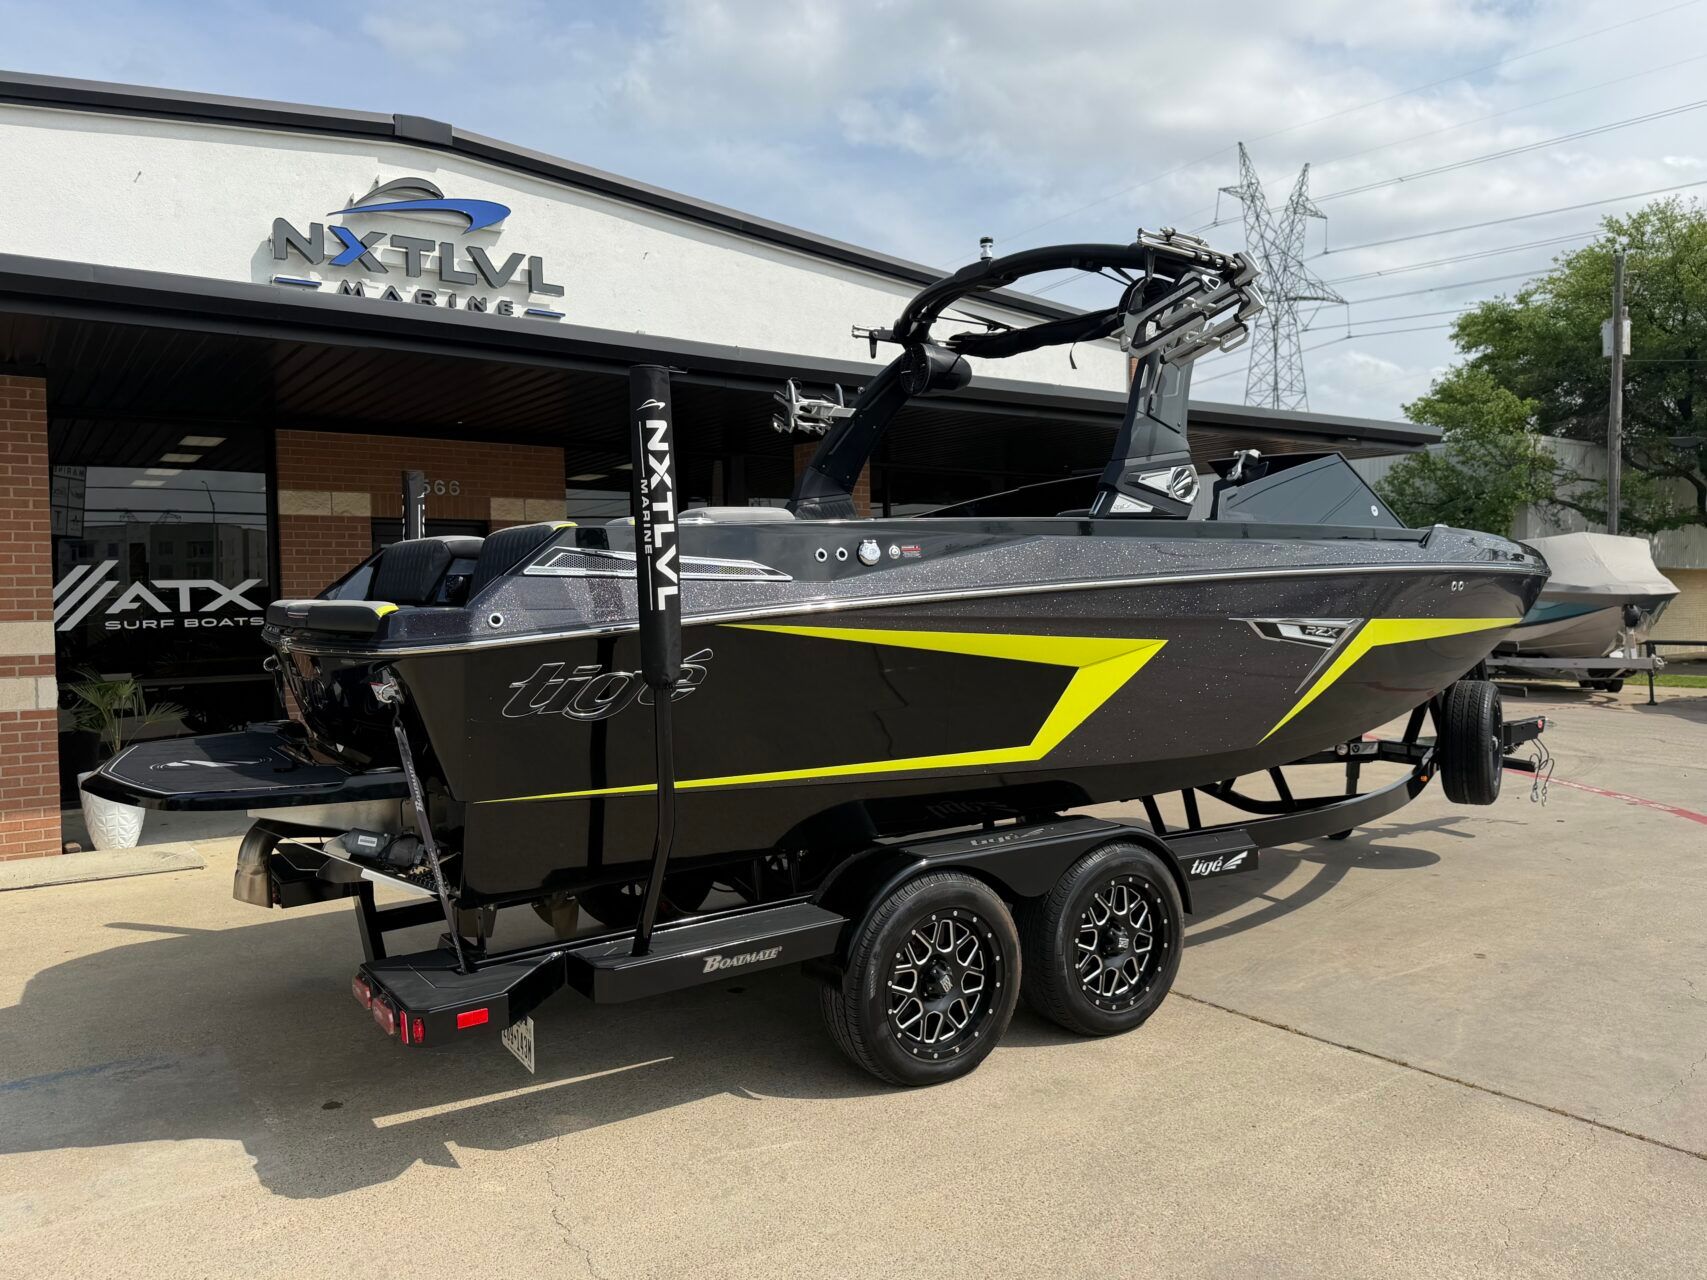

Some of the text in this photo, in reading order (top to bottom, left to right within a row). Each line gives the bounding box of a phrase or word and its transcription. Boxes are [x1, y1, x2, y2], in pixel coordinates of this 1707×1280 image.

[272, 217, 565, 297] NXTLVL
[338, 279, 514, 315] MARINE
[640, 478, 653, 555] MARINE
[645, 419, 679, 611] NXTLVL
[104, 578, 264, 614] ATX
[104, 616, 265, 630] SURF BOATS
